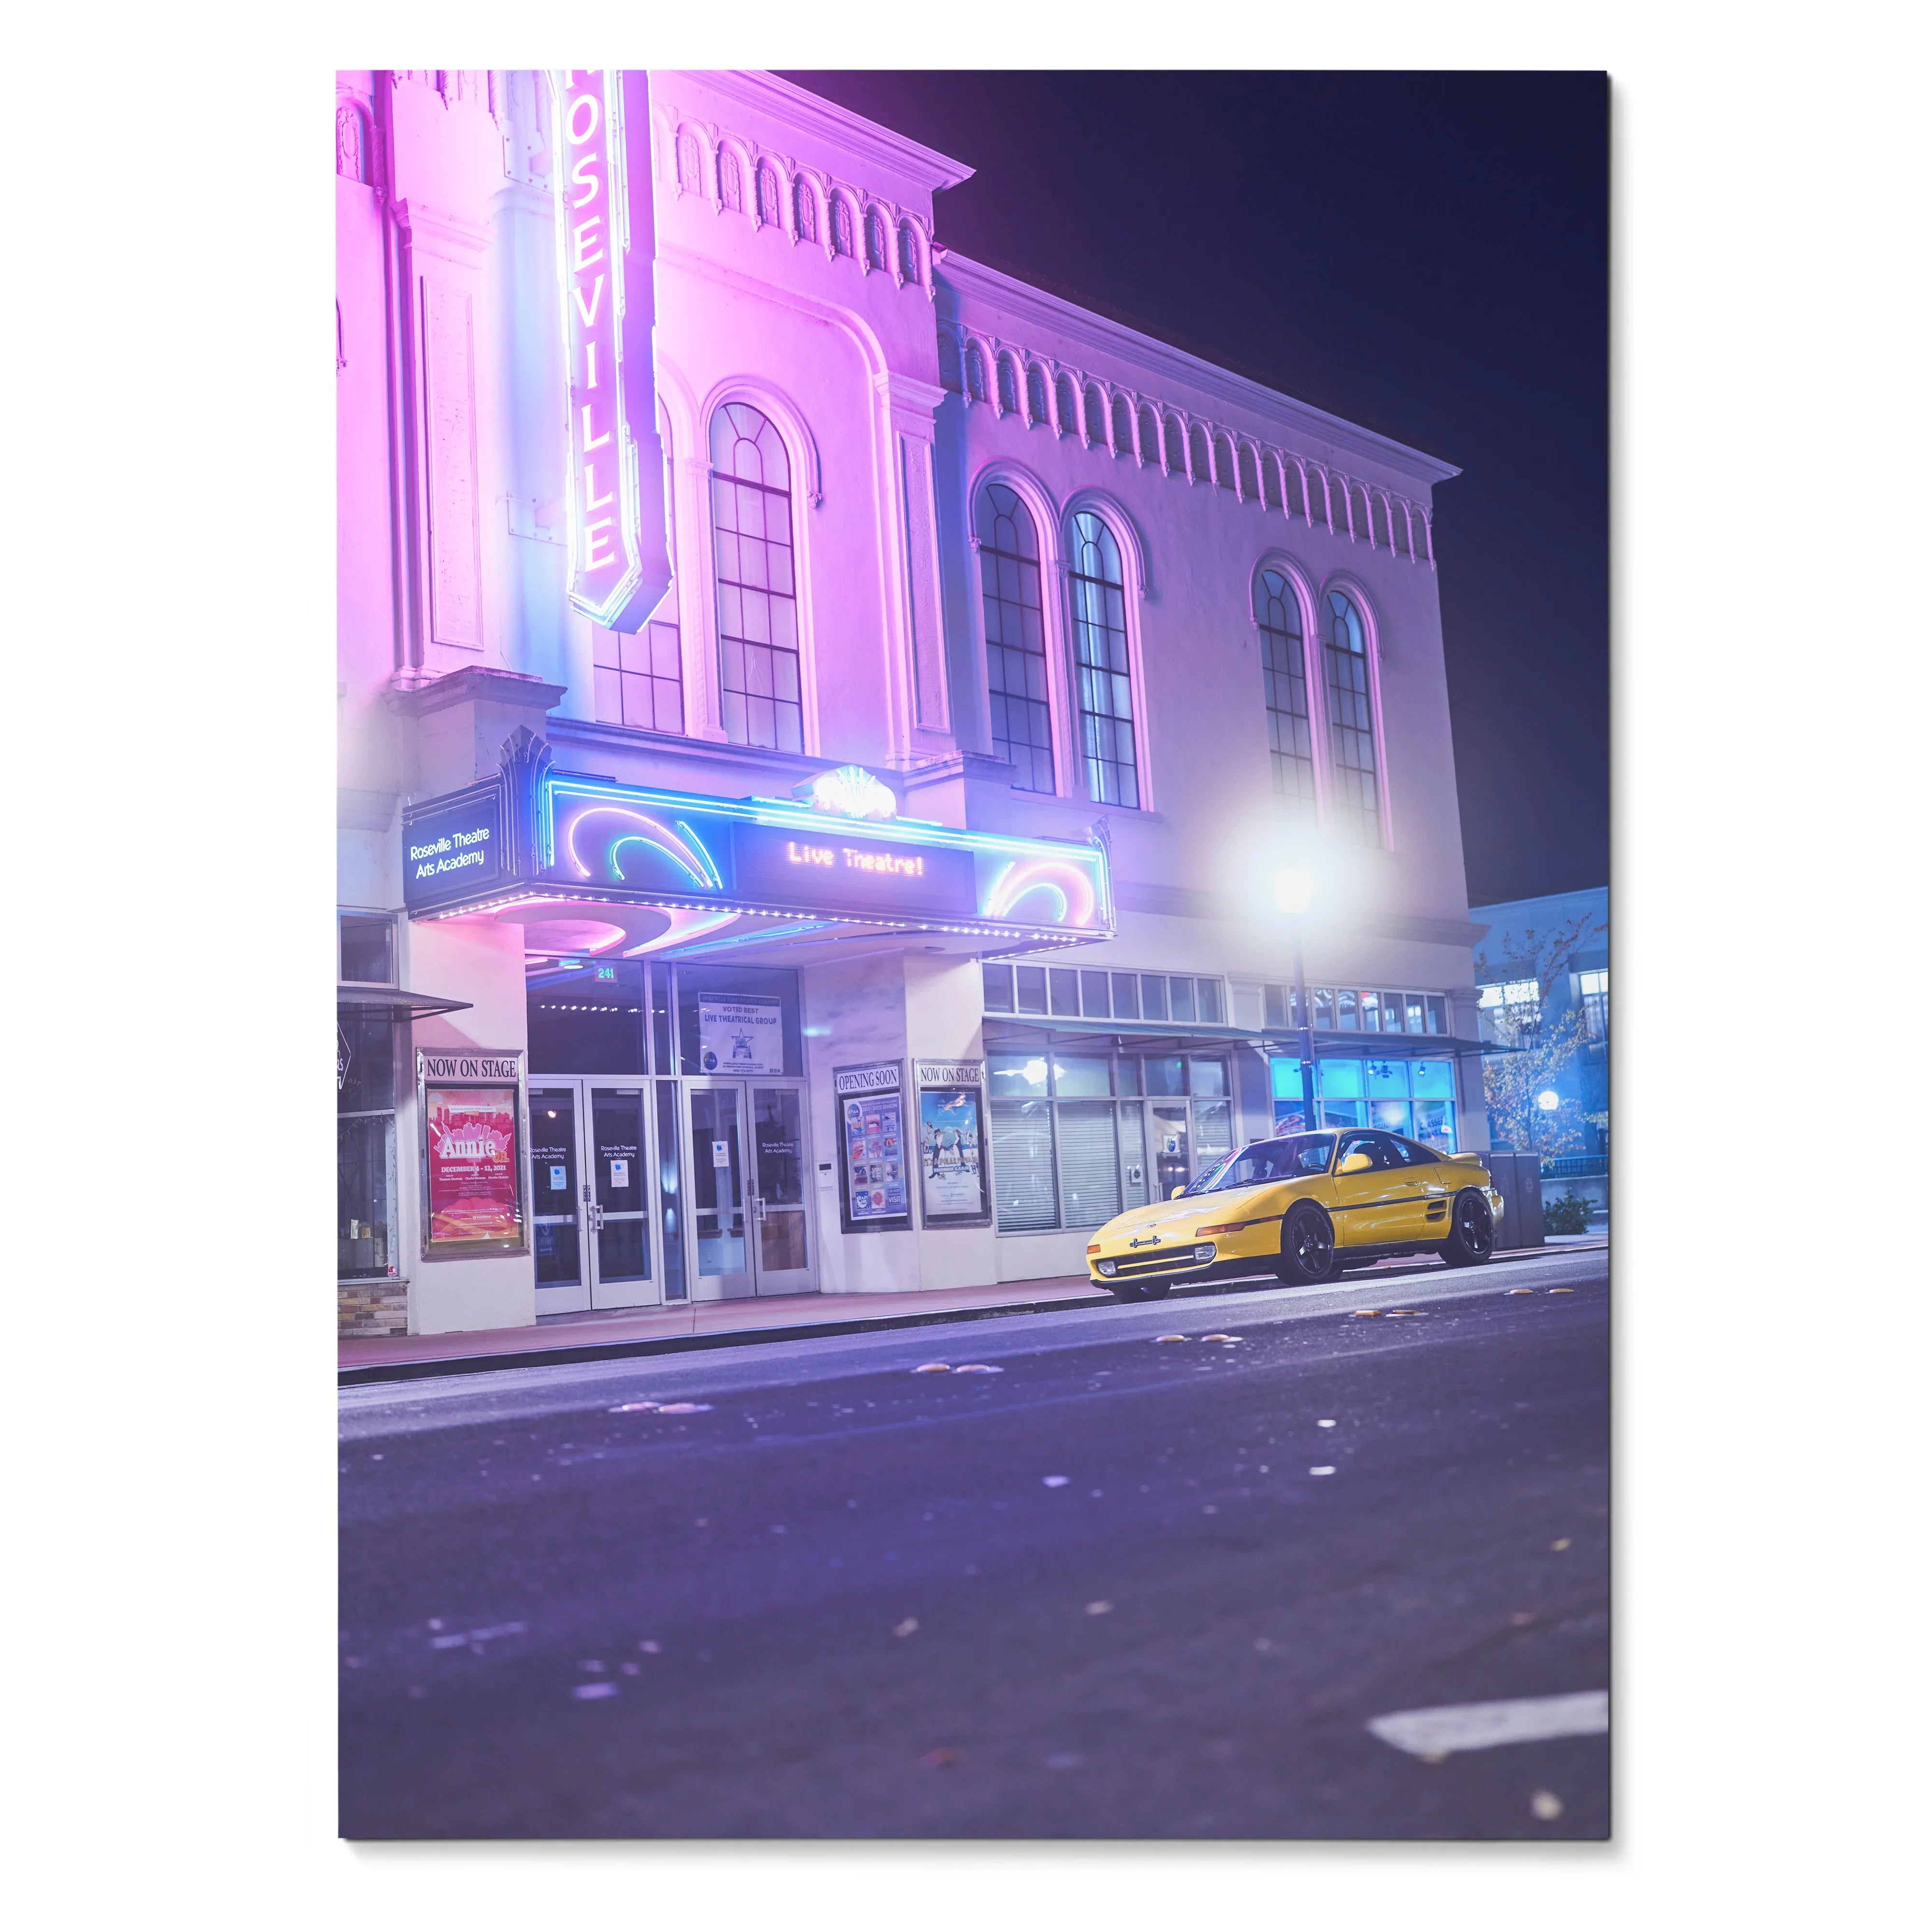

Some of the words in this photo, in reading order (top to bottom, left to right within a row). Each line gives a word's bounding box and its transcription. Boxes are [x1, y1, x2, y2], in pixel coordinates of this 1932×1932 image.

[411, 837, 451, 861] Roseville
[453, 827, 490, 849] Theatre
[788, 841, 834, 866] Live
[415, 862, 435, 880] Arts
[436, 850, 484, 874] Academy
[598, 967, 614, 979] 241
[718, 1015, 754, 1024] THEATRICAL
[427, 1059, 457, 1077] NOW
[460, 1059, 478, 1077] ON
[482, 1060, 516, 1078] STAGE
[921, 1067, 940, 1082] NOW
[942, 1068, 954, 1082] ON
[956, 1068, 980, 1082] STAGE
[839, 1073, 875, 1090] OPENING
[876, 1069, 897, 1086] SOON
[440, 1136, 496, 1159] Annie
